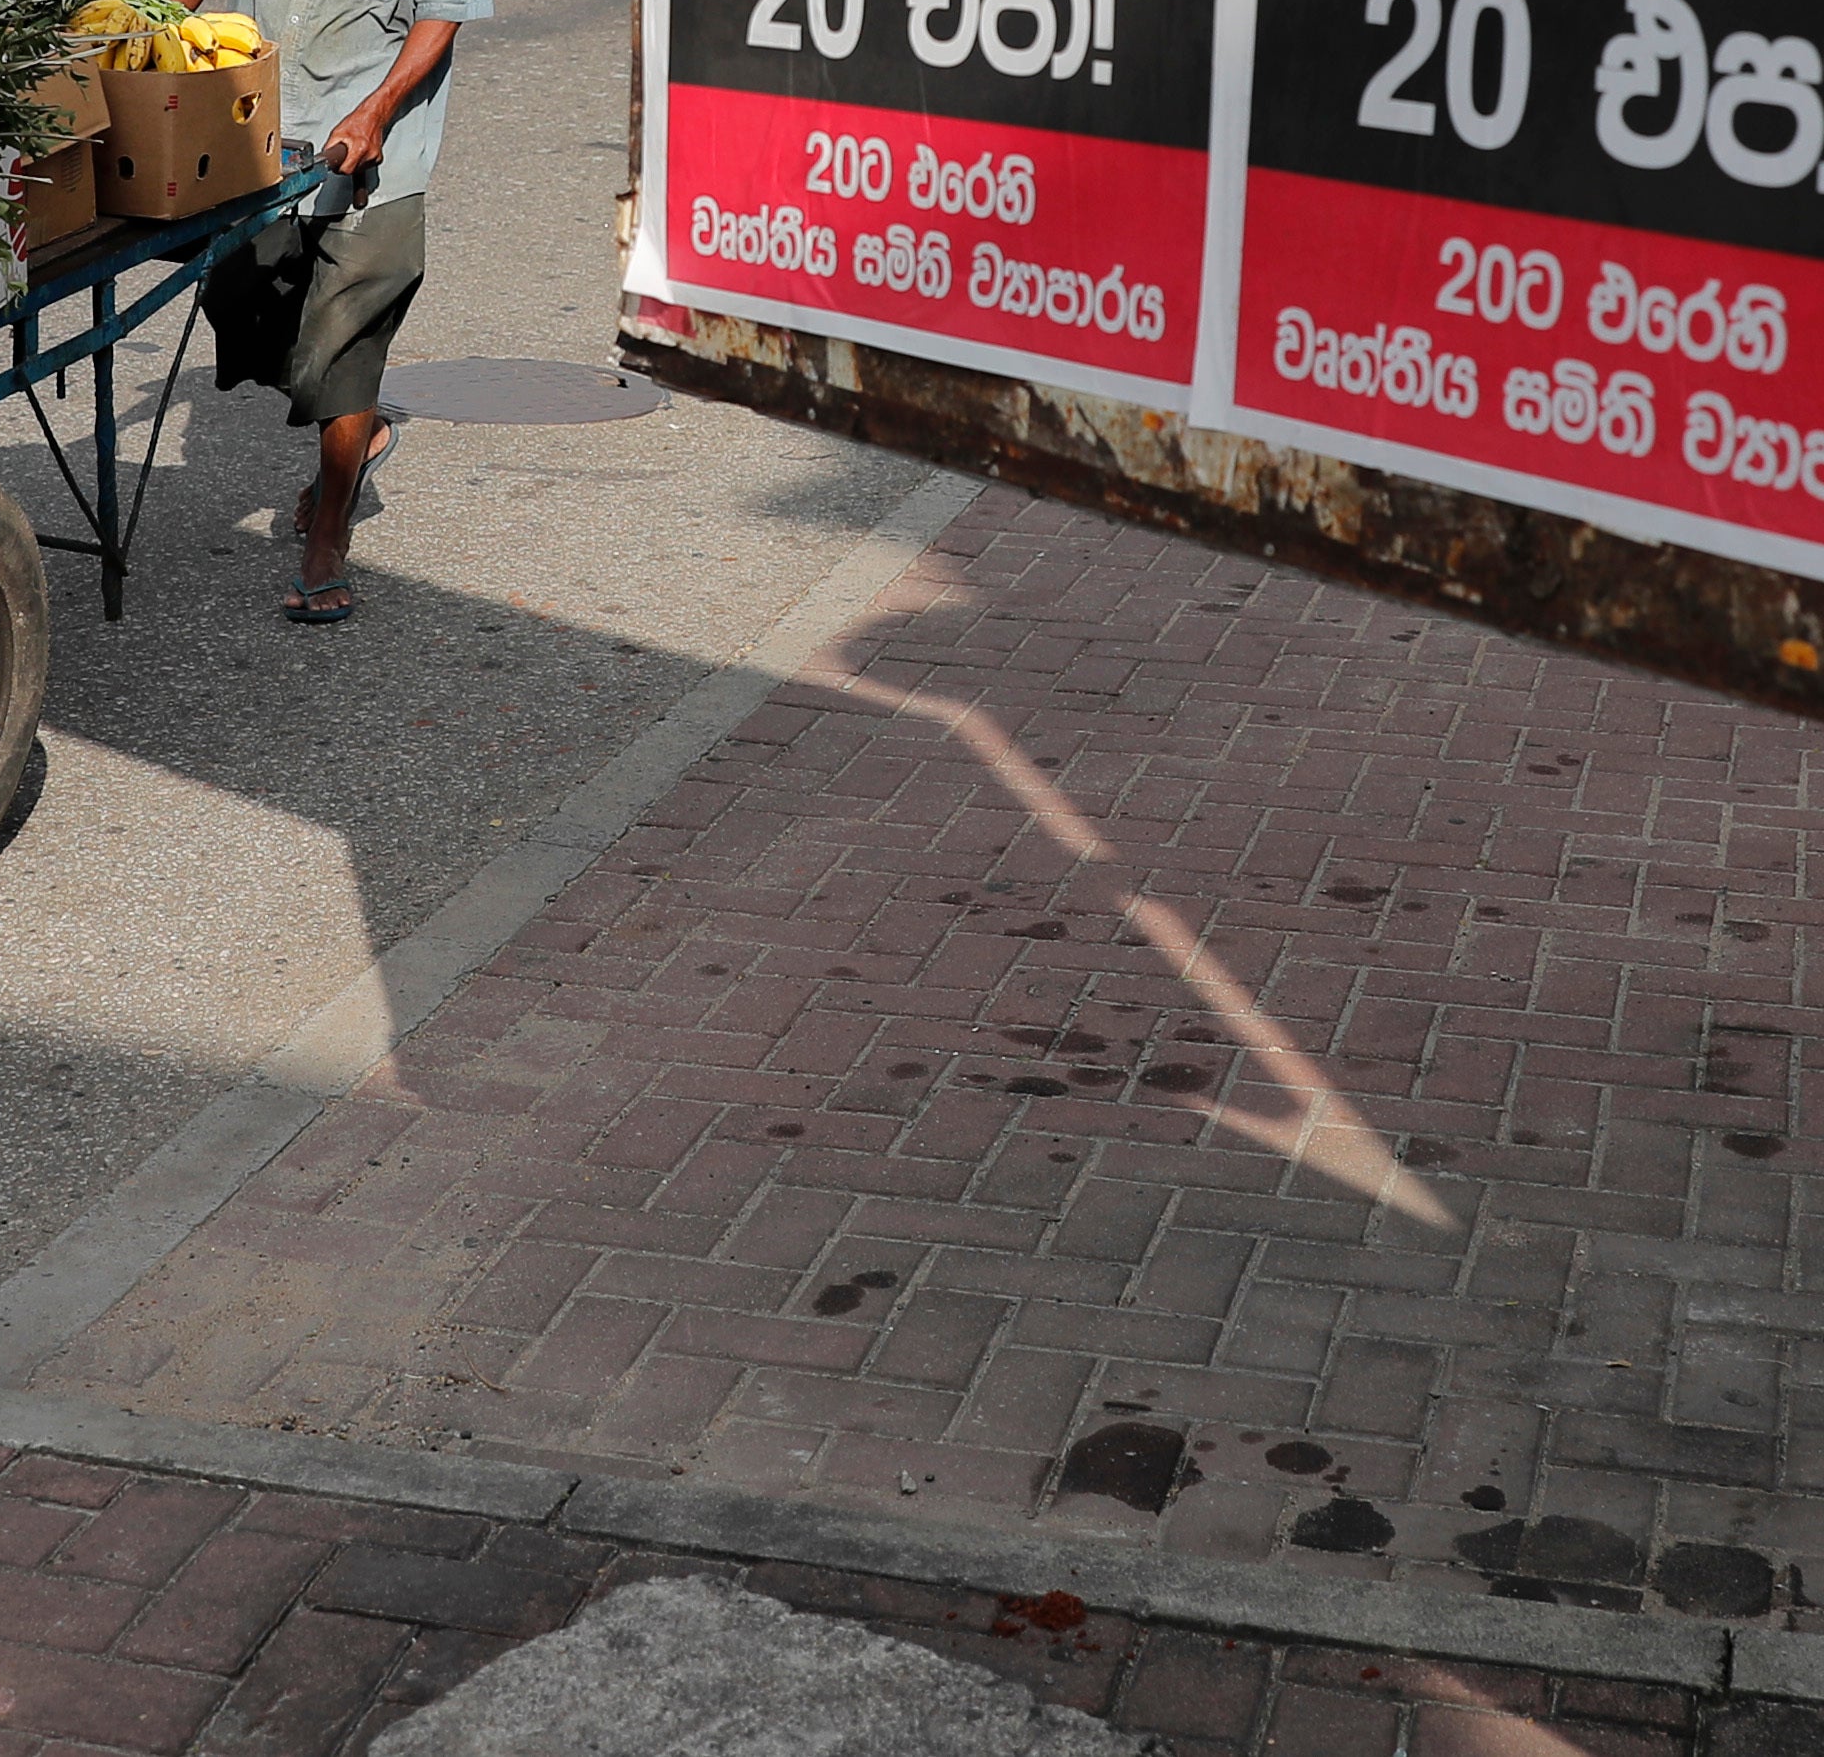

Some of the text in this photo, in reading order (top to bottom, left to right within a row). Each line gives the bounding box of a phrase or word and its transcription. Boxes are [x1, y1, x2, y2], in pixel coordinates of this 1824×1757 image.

[804, 131, 1037, 225] 20ට එරෙහි
[690, 195, 838, 277] වෘත්තීය
[853, 225, 952, 299] සමිති
[1435, 237, 1789, 375] 20ට එරෙහි
[1273, 306, 1480, 420] වෘත්තීය
[1503, 357, 1655, 458] සමිති
